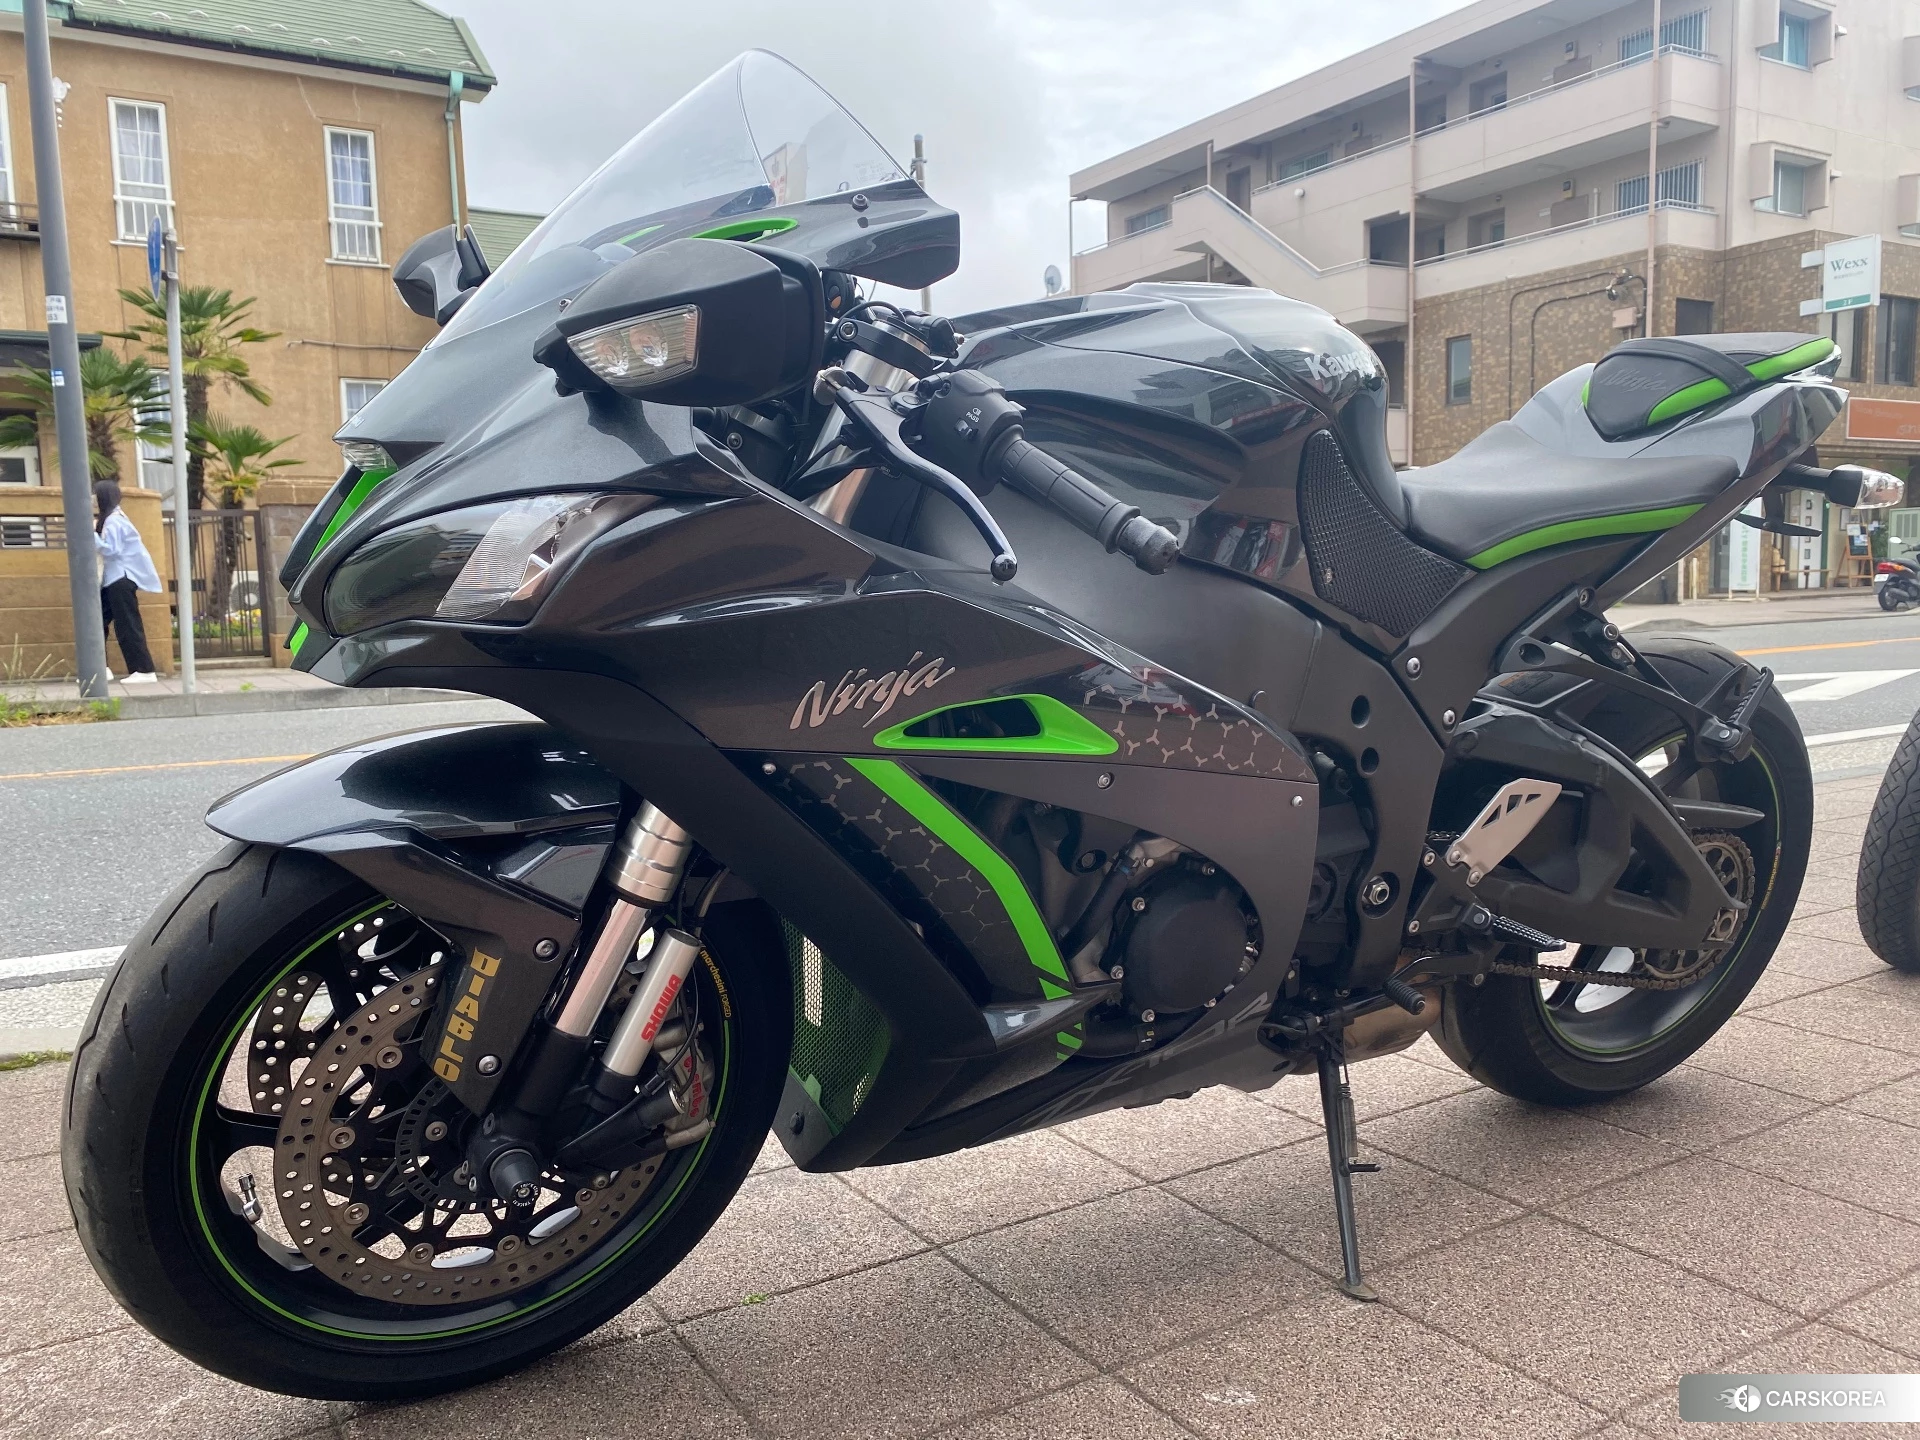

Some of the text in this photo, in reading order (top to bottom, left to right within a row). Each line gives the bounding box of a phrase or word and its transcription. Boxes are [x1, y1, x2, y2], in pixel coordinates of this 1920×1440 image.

[1830, 257, 1868, 272] Wexx
[1598, 368, 1667, 394] Ninja
[966, 411, 980, 423] PASS
[789, 650, 956, 730] Ninja
[433, 946, 501, 1082] DIABLO
[641, 974, 682, 1043] SHOWA
[700, 949, 731, 1018] marchesini FORGED
